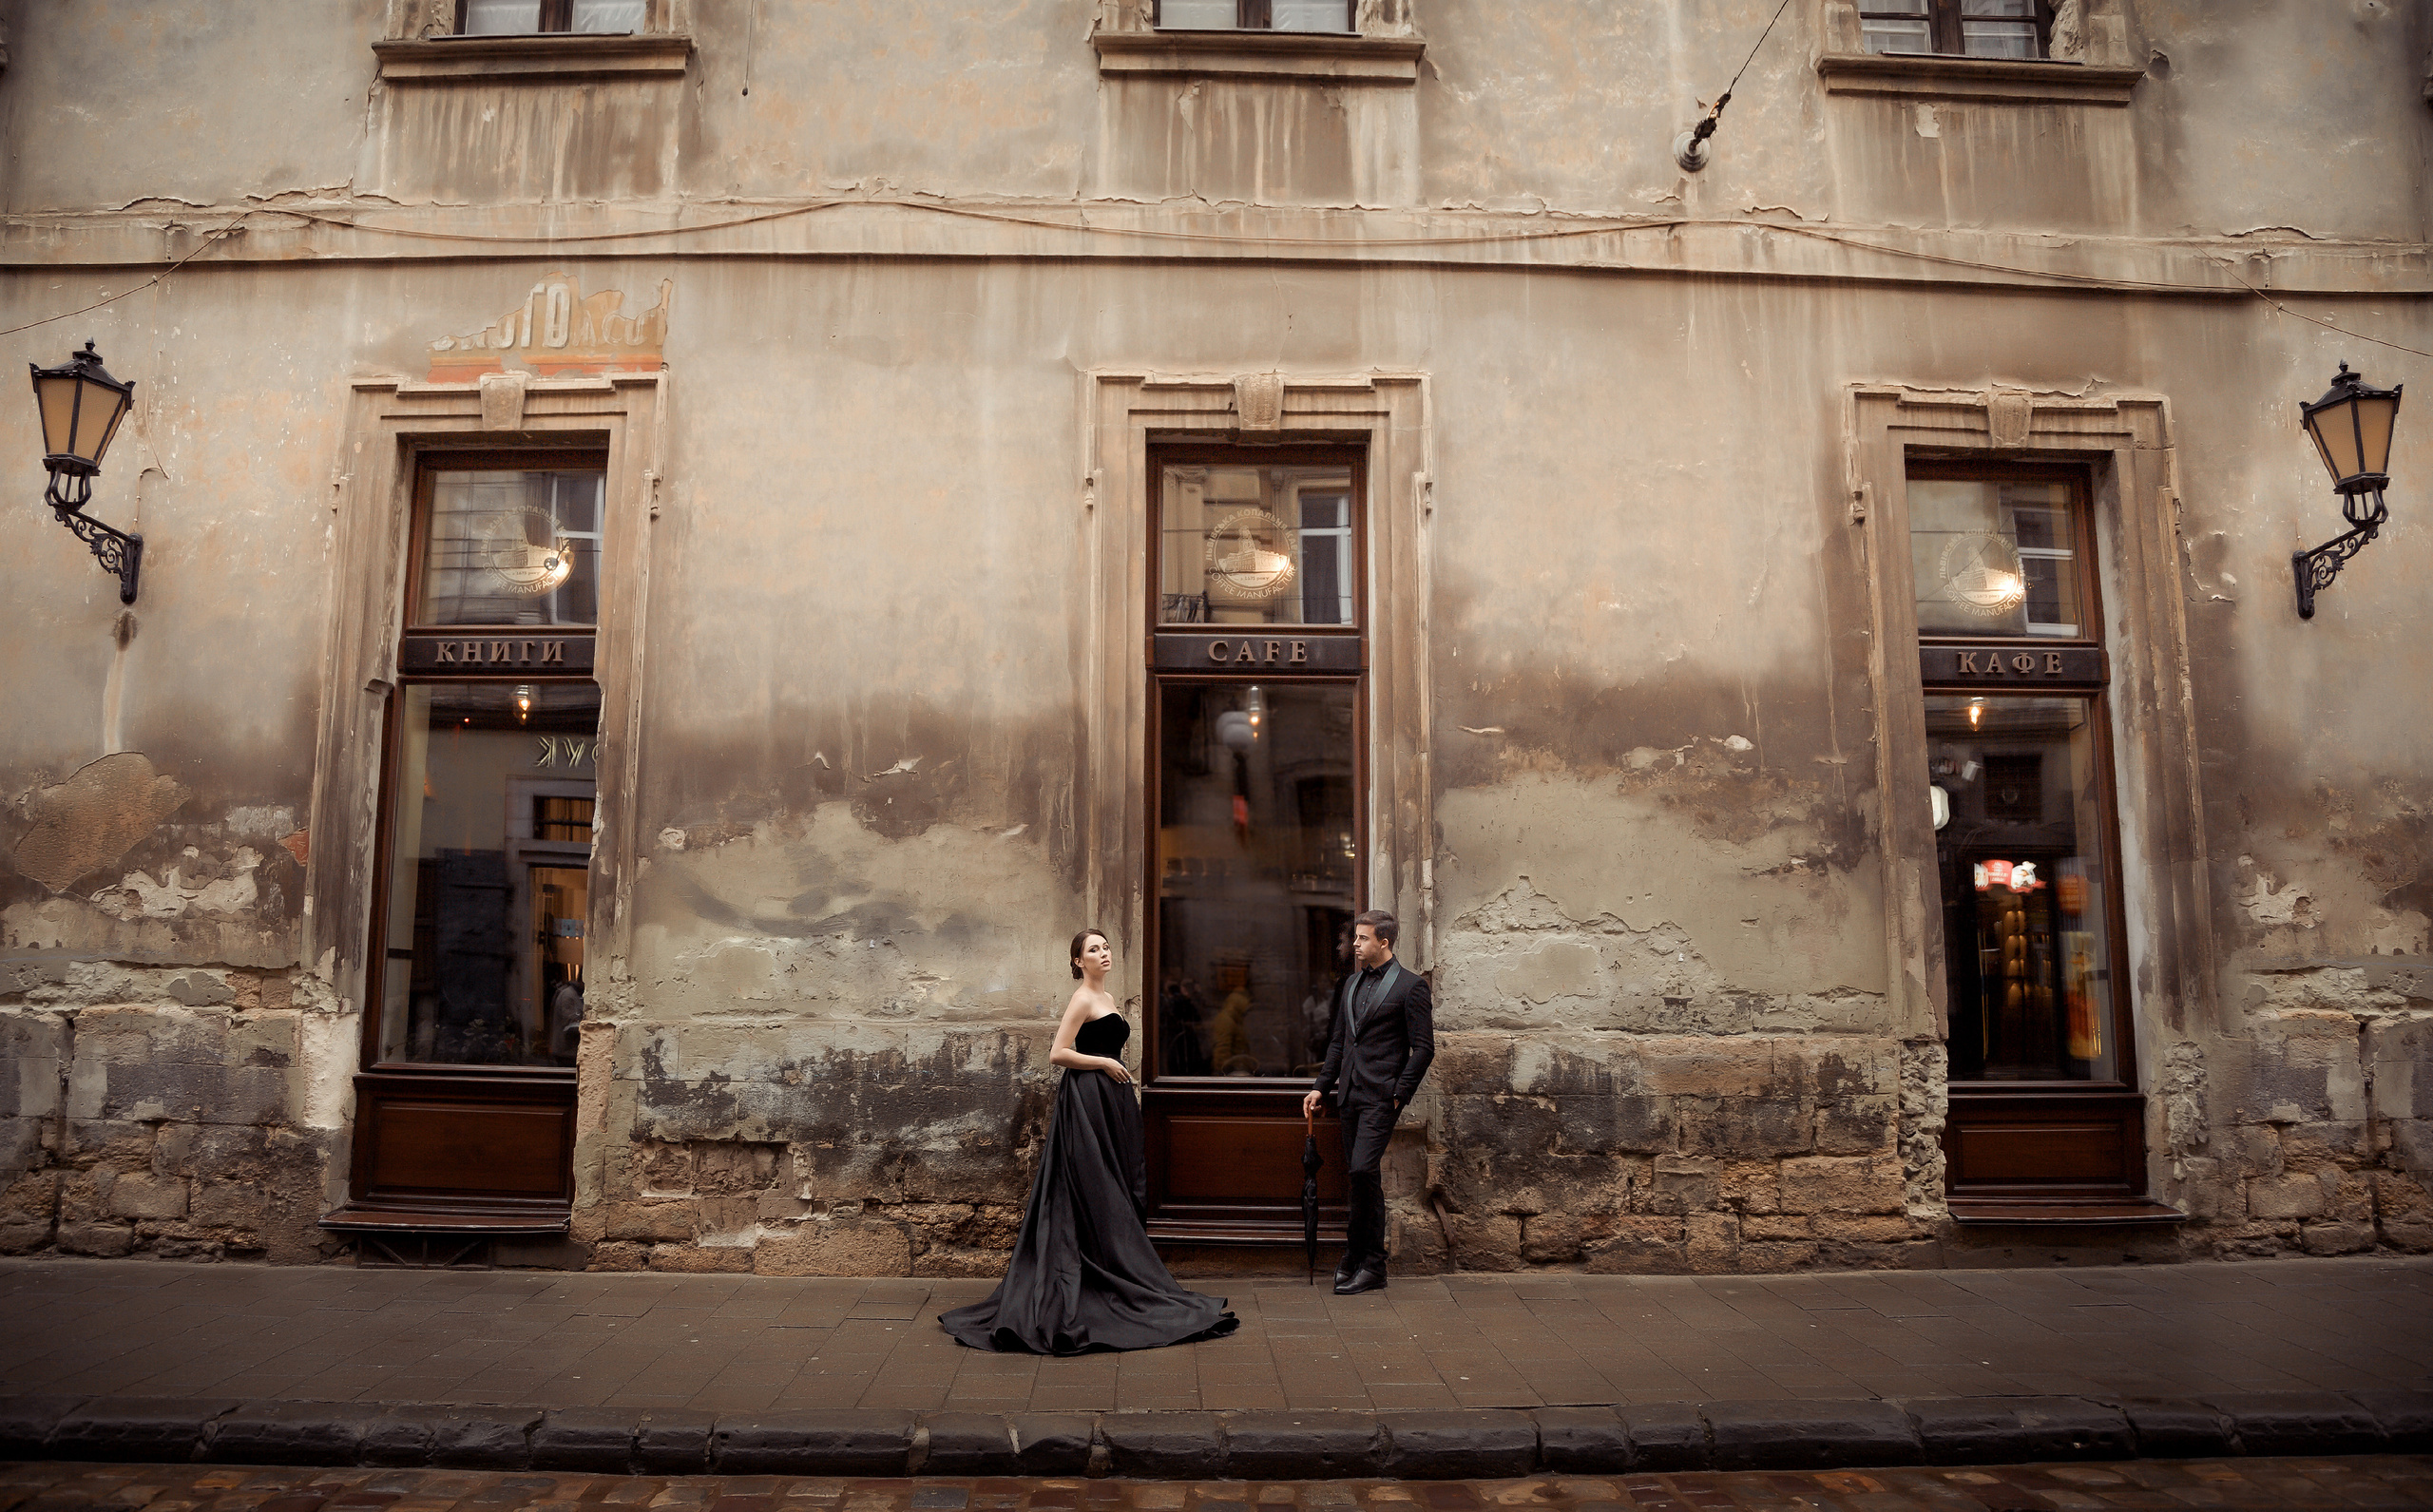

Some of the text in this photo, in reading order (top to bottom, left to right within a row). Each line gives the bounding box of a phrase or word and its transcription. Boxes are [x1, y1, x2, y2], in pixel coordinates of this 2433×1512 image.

[1205, 513, 1236, 561] ЛЬВІВСЬКА
[1237, 508, 1288, 530] КОПАЛЬНЯ
[1939, 533, 1964, 579] ЛЬВІВСЬКА
[483, 559, 569, 594] COFFEE MANUFACTE
[1208, 565, 1297, 599] COFFEE MANUFACTURE
[1944, 584, 1969, 612] COFFEE
[434, 641, 565, 664] КНИГИ
[1208, 641, 1308, 663] CAFE
[1958, 651, 2063, 675] КАФЕ
